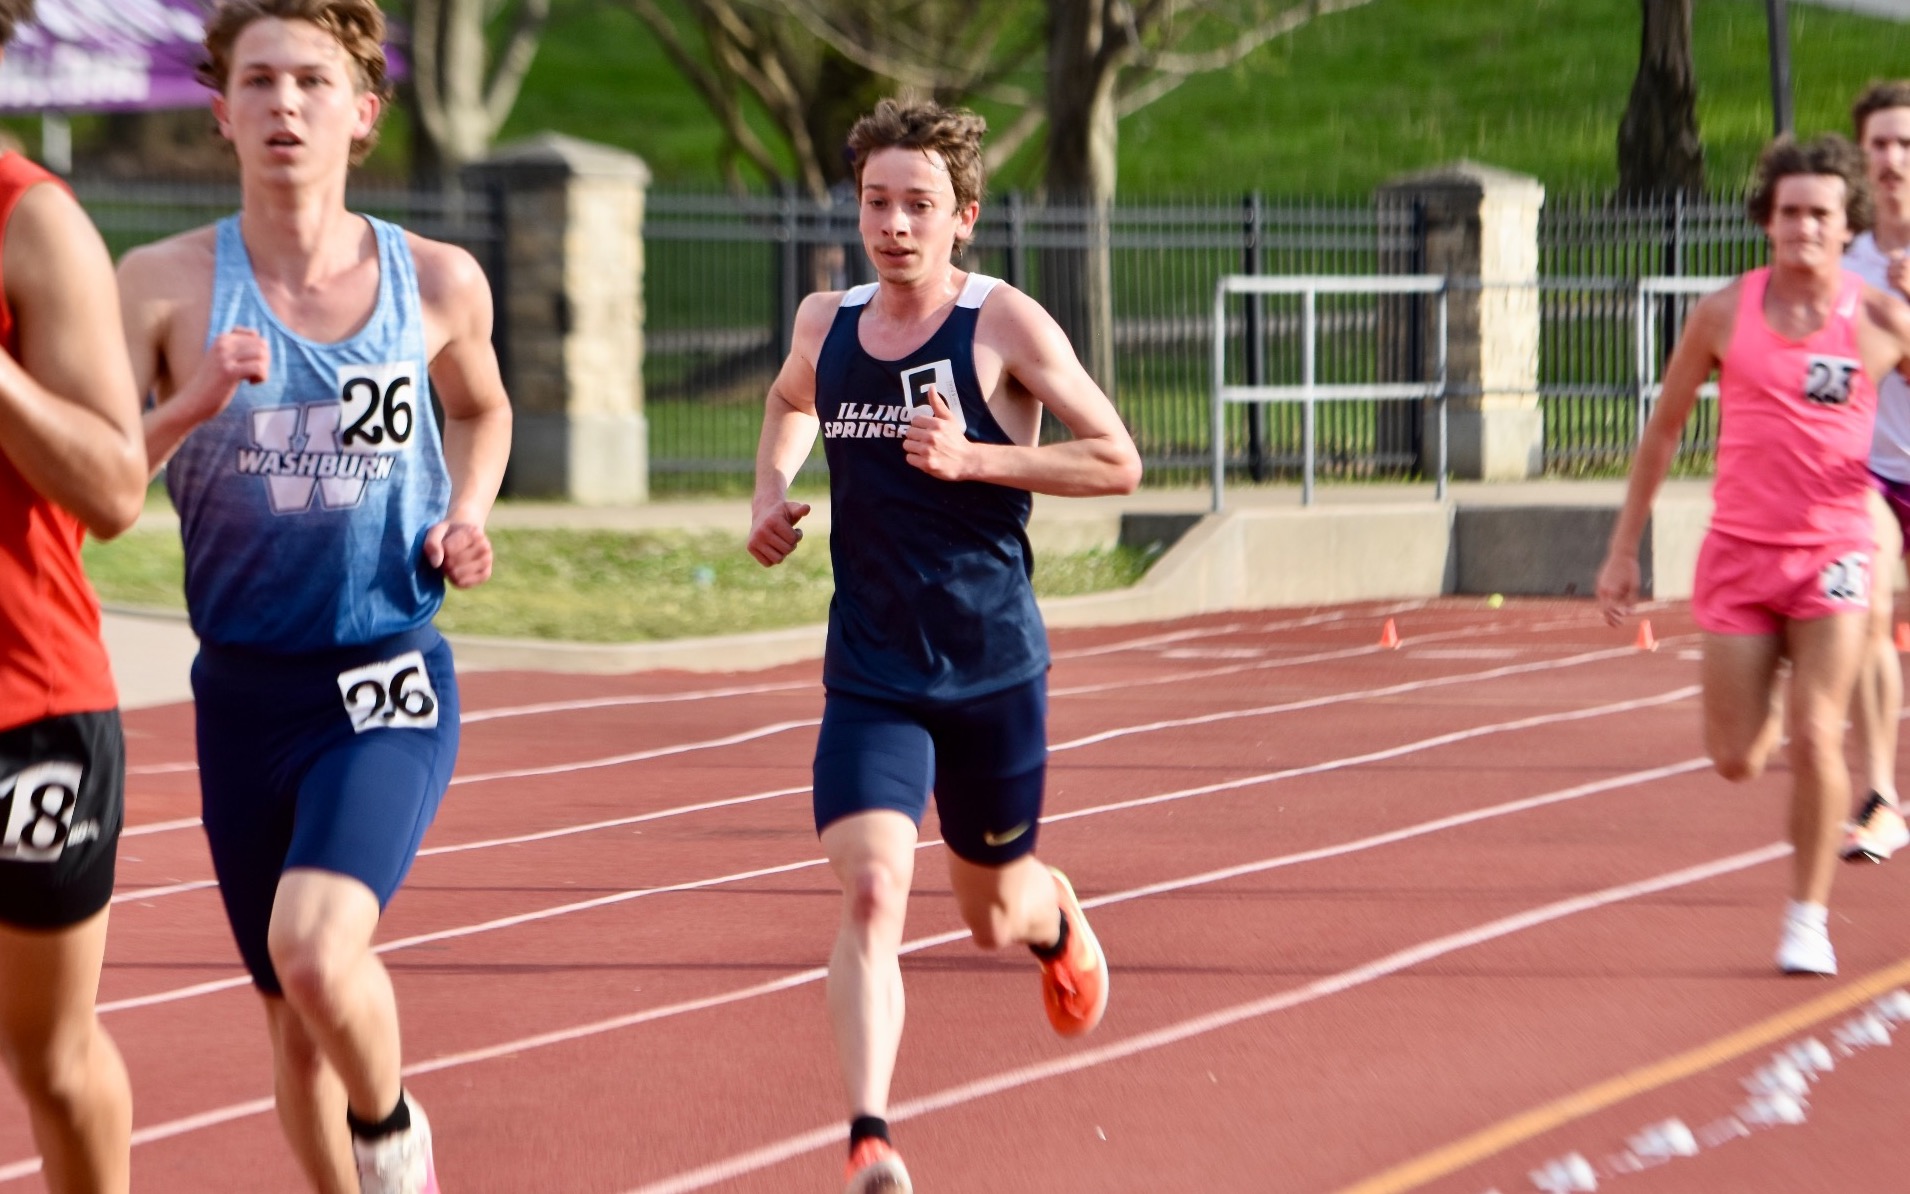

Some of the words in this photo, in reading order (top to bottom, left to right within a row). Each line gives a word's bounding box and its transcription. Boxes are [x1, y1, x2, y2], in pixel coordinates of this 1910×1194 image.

[342, 376, 413, 446] 26
[236, 449, 397, 481] WASHBURN
[346, 666, 435, 727] 26
